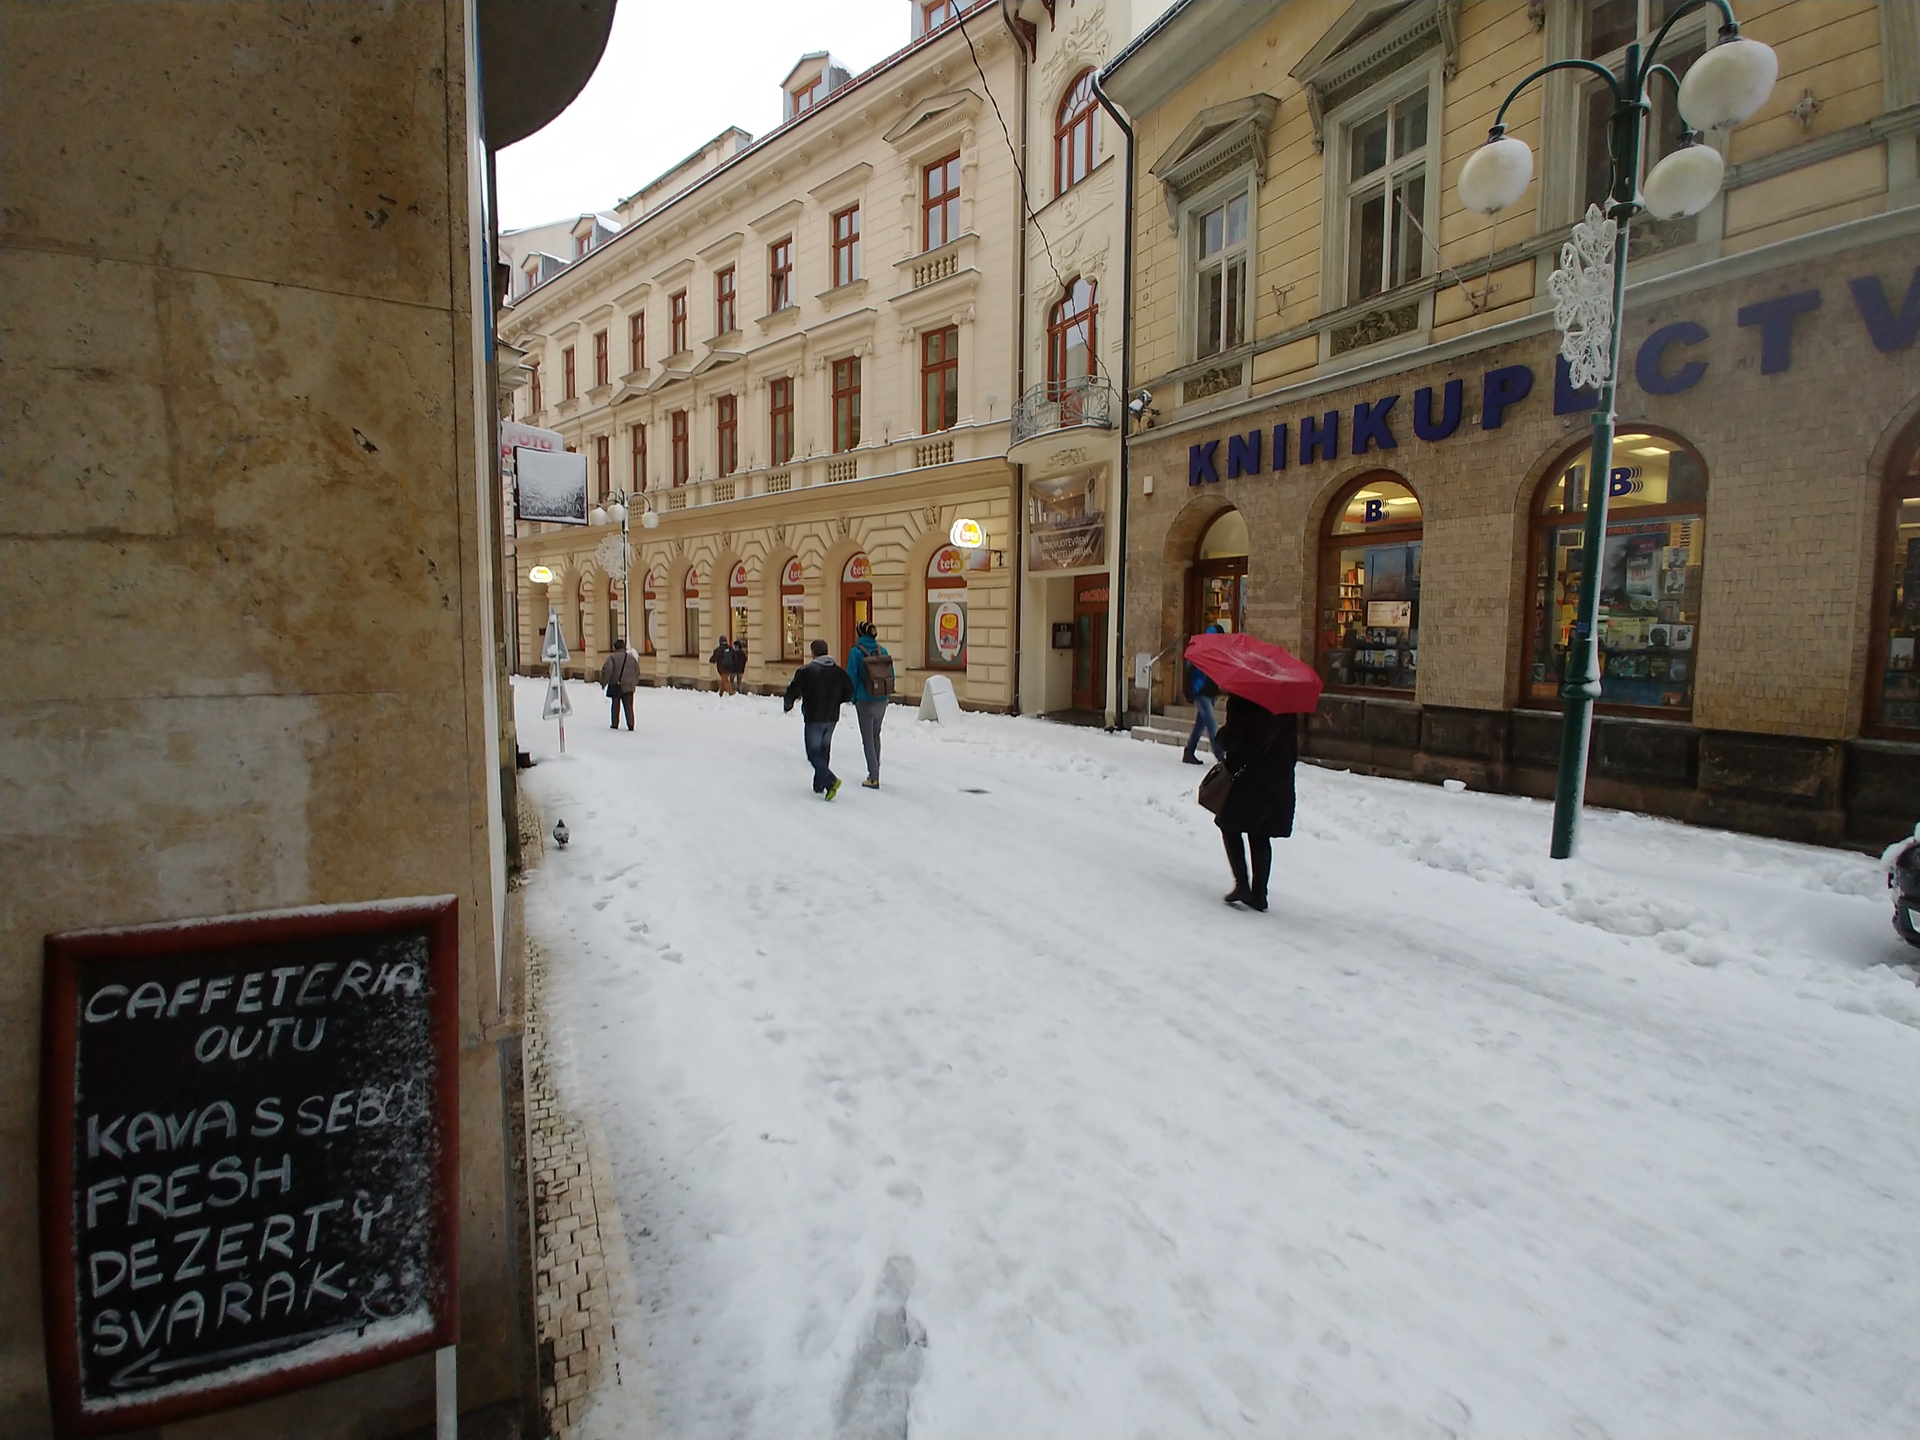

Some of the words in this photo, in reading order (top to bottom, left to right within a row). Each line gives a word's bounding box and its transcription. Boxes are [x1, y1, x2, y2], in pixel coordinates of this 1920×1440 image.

[940, 559, 961, 570] teta
[84, 960, 424, 1023] CAFFETERIA
[194, 1017, 327, 1064] OUTU
[87, 1100, 238, 1159] KAVA
[250, 1098, 285, 1137] S
[86, 1153, 292, 1228] FRESH
